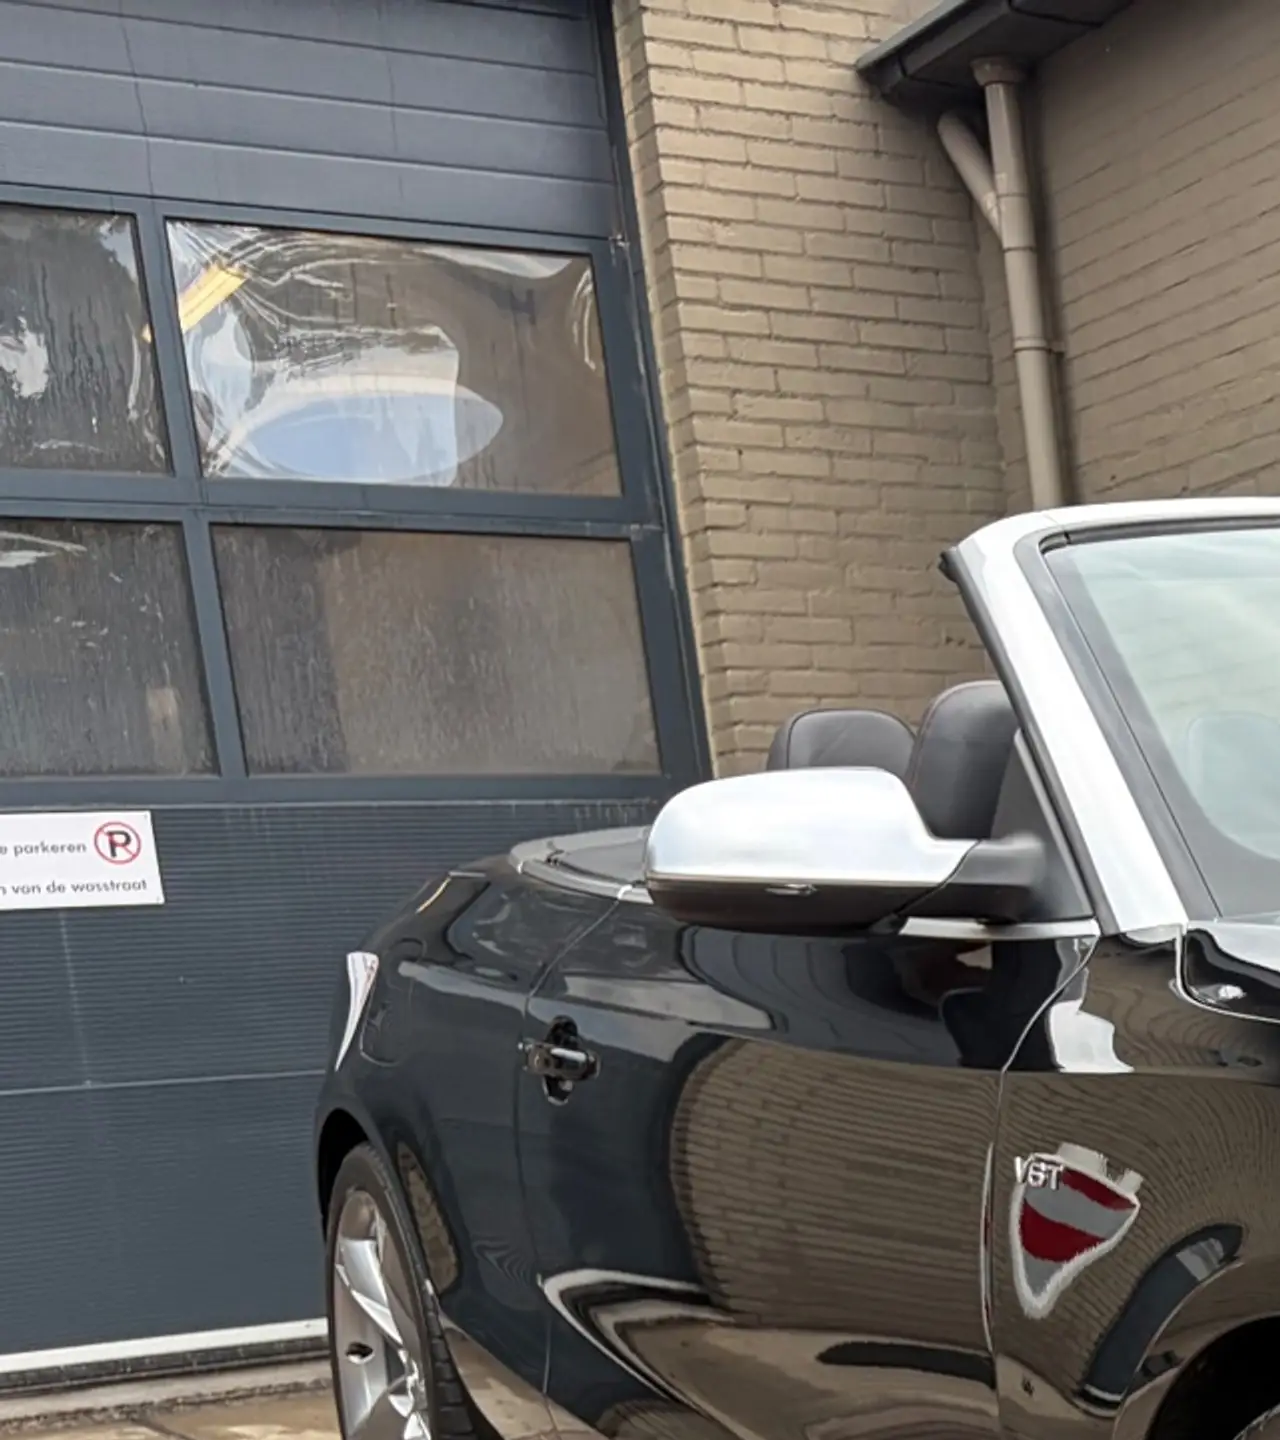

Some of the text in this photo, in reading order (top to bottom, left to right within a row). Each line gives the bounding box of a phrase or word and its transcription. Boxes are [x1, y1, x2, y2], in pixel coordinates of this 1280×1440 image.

[14, 840, 87, 857] parkeren
[11, 885, 42, 894] van
[46, 880, 66, 893] de
[71, 879, 147, 893] wasstraat
